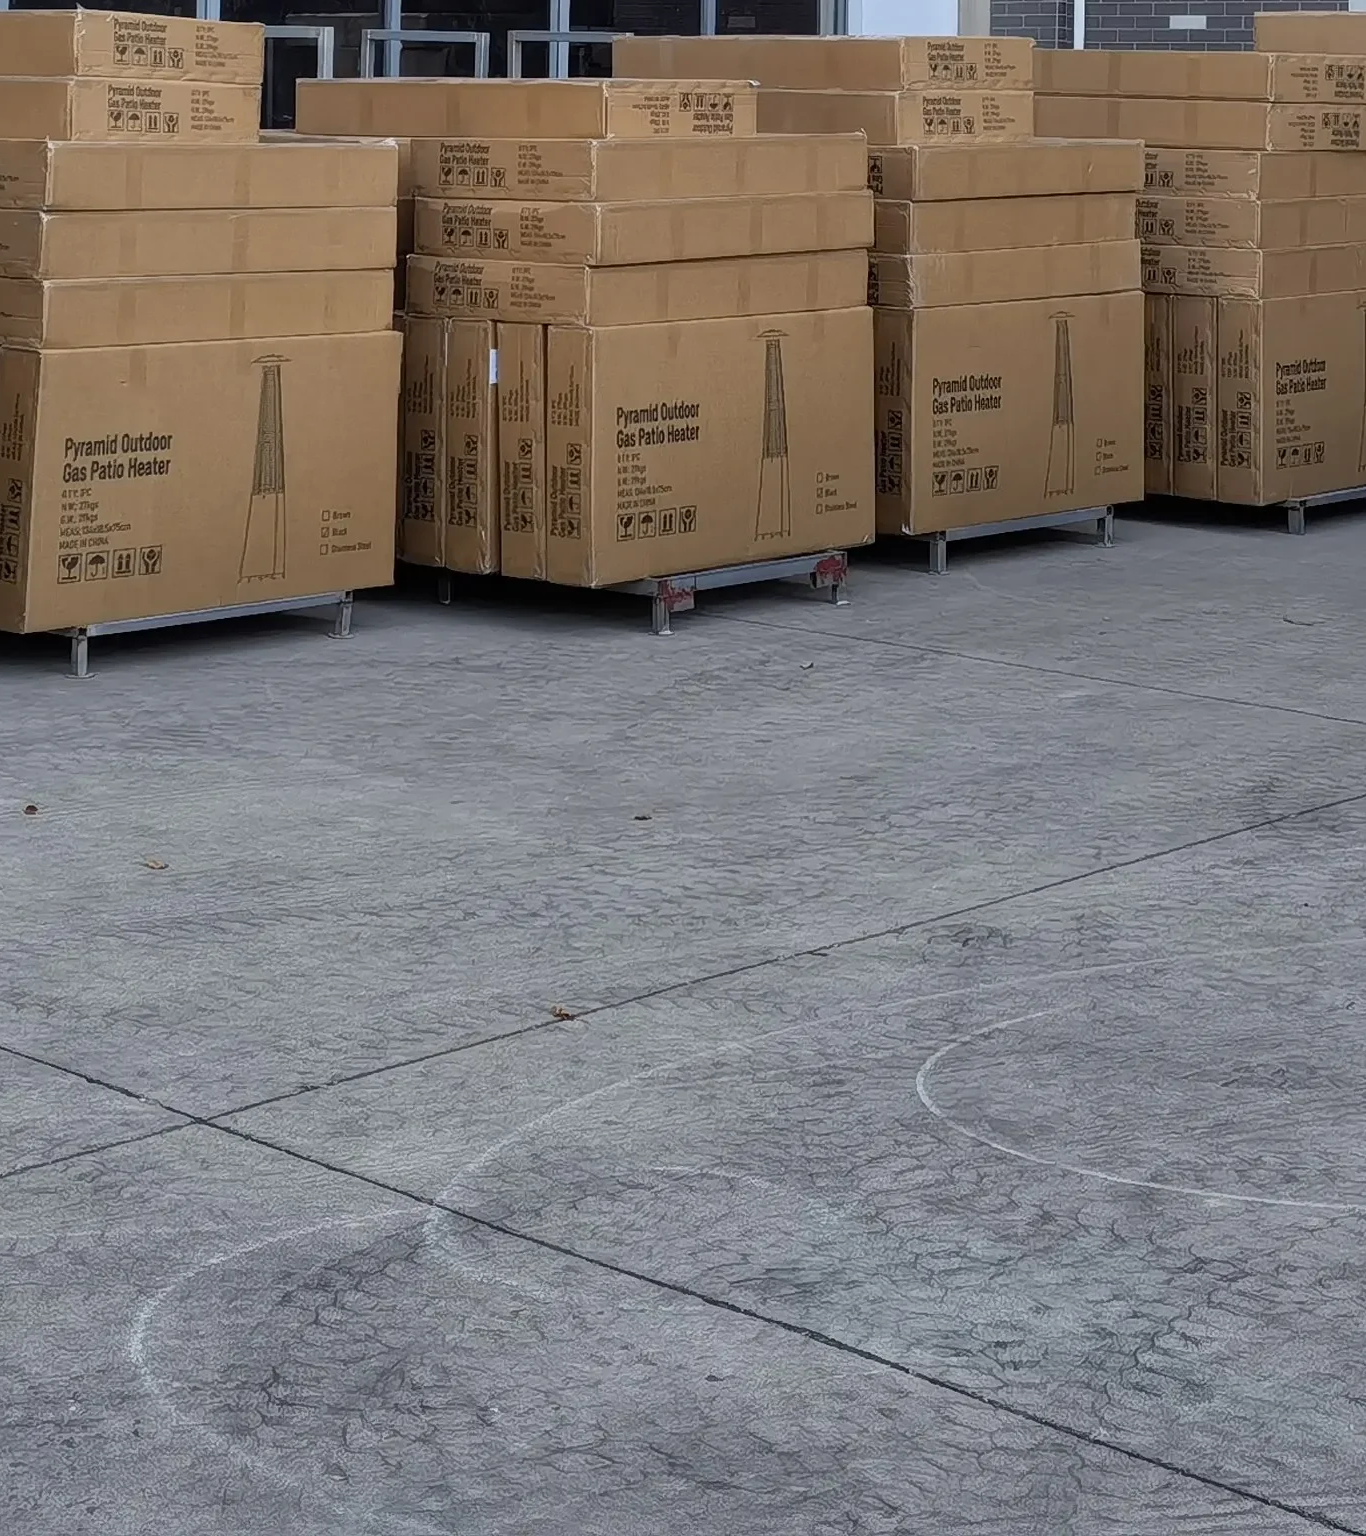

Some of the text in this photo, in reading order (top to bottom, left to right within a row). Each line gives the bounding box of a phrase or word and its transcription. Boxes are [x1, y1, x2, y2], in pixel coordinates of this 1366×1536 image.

[933, 373, 1002, 397] Pyramid Outdoor
[617, 400, 700, 428] Pyramid Outdoor
[933, 394, 1002, 414] Gas Patio Heater
[65, 432, 173, 461] Pyramid Outdoor
[617, 424, 700, 449] Gas Patio Heater
[62, 456, 171, 483] Gas Patio Heater
